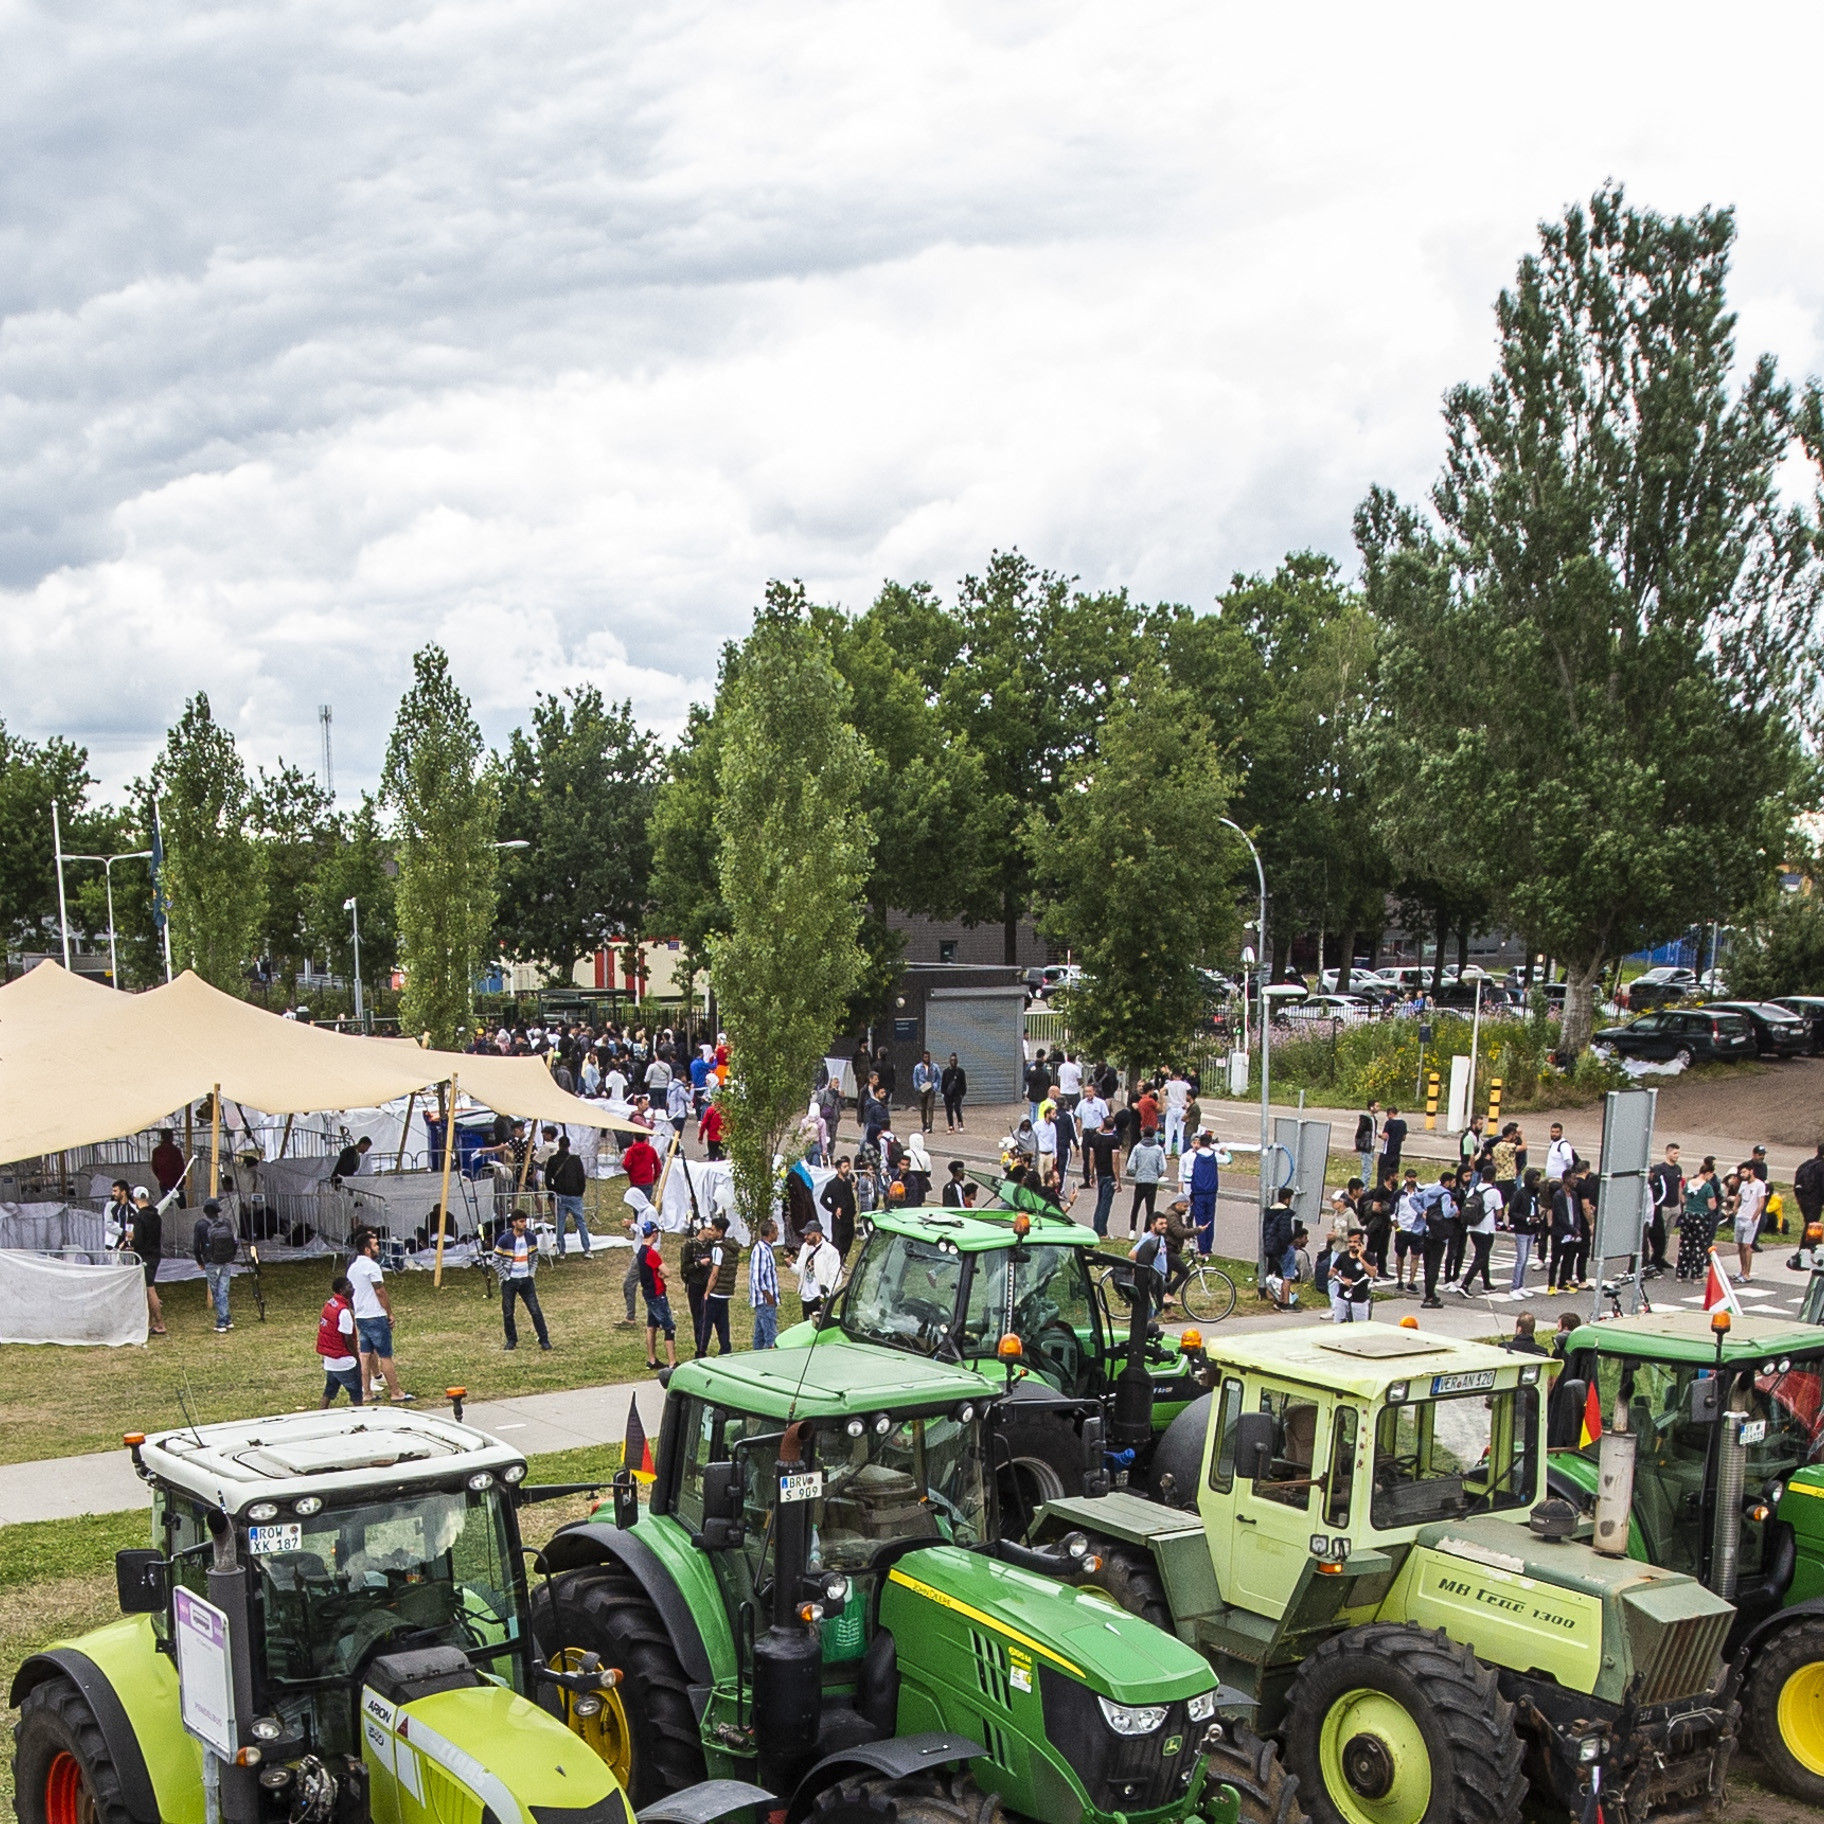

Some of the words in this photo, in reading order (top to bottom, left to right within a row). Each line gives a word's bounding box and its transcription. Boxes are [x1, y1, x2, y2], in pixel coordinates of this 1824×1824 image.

[1440, 1376, 1458, 1391] VER
[1463, 1375, 1475, 1388] AN
[789, 1476, 809, 1489] BRV
[786, 1490, 792, 1501] S
[259, 1526, 283, 1540] ROW
[254, 1540, 271, 1553] XK
[913, 1583, 930, 1598] JOHN
[928, 1590, 952, 1608] DEERE
[1438, 1577, 1471, 1597] MB
[1532, 1608, 1576, 1630] 1300
[367, 1699, 392, 1725] ARION
